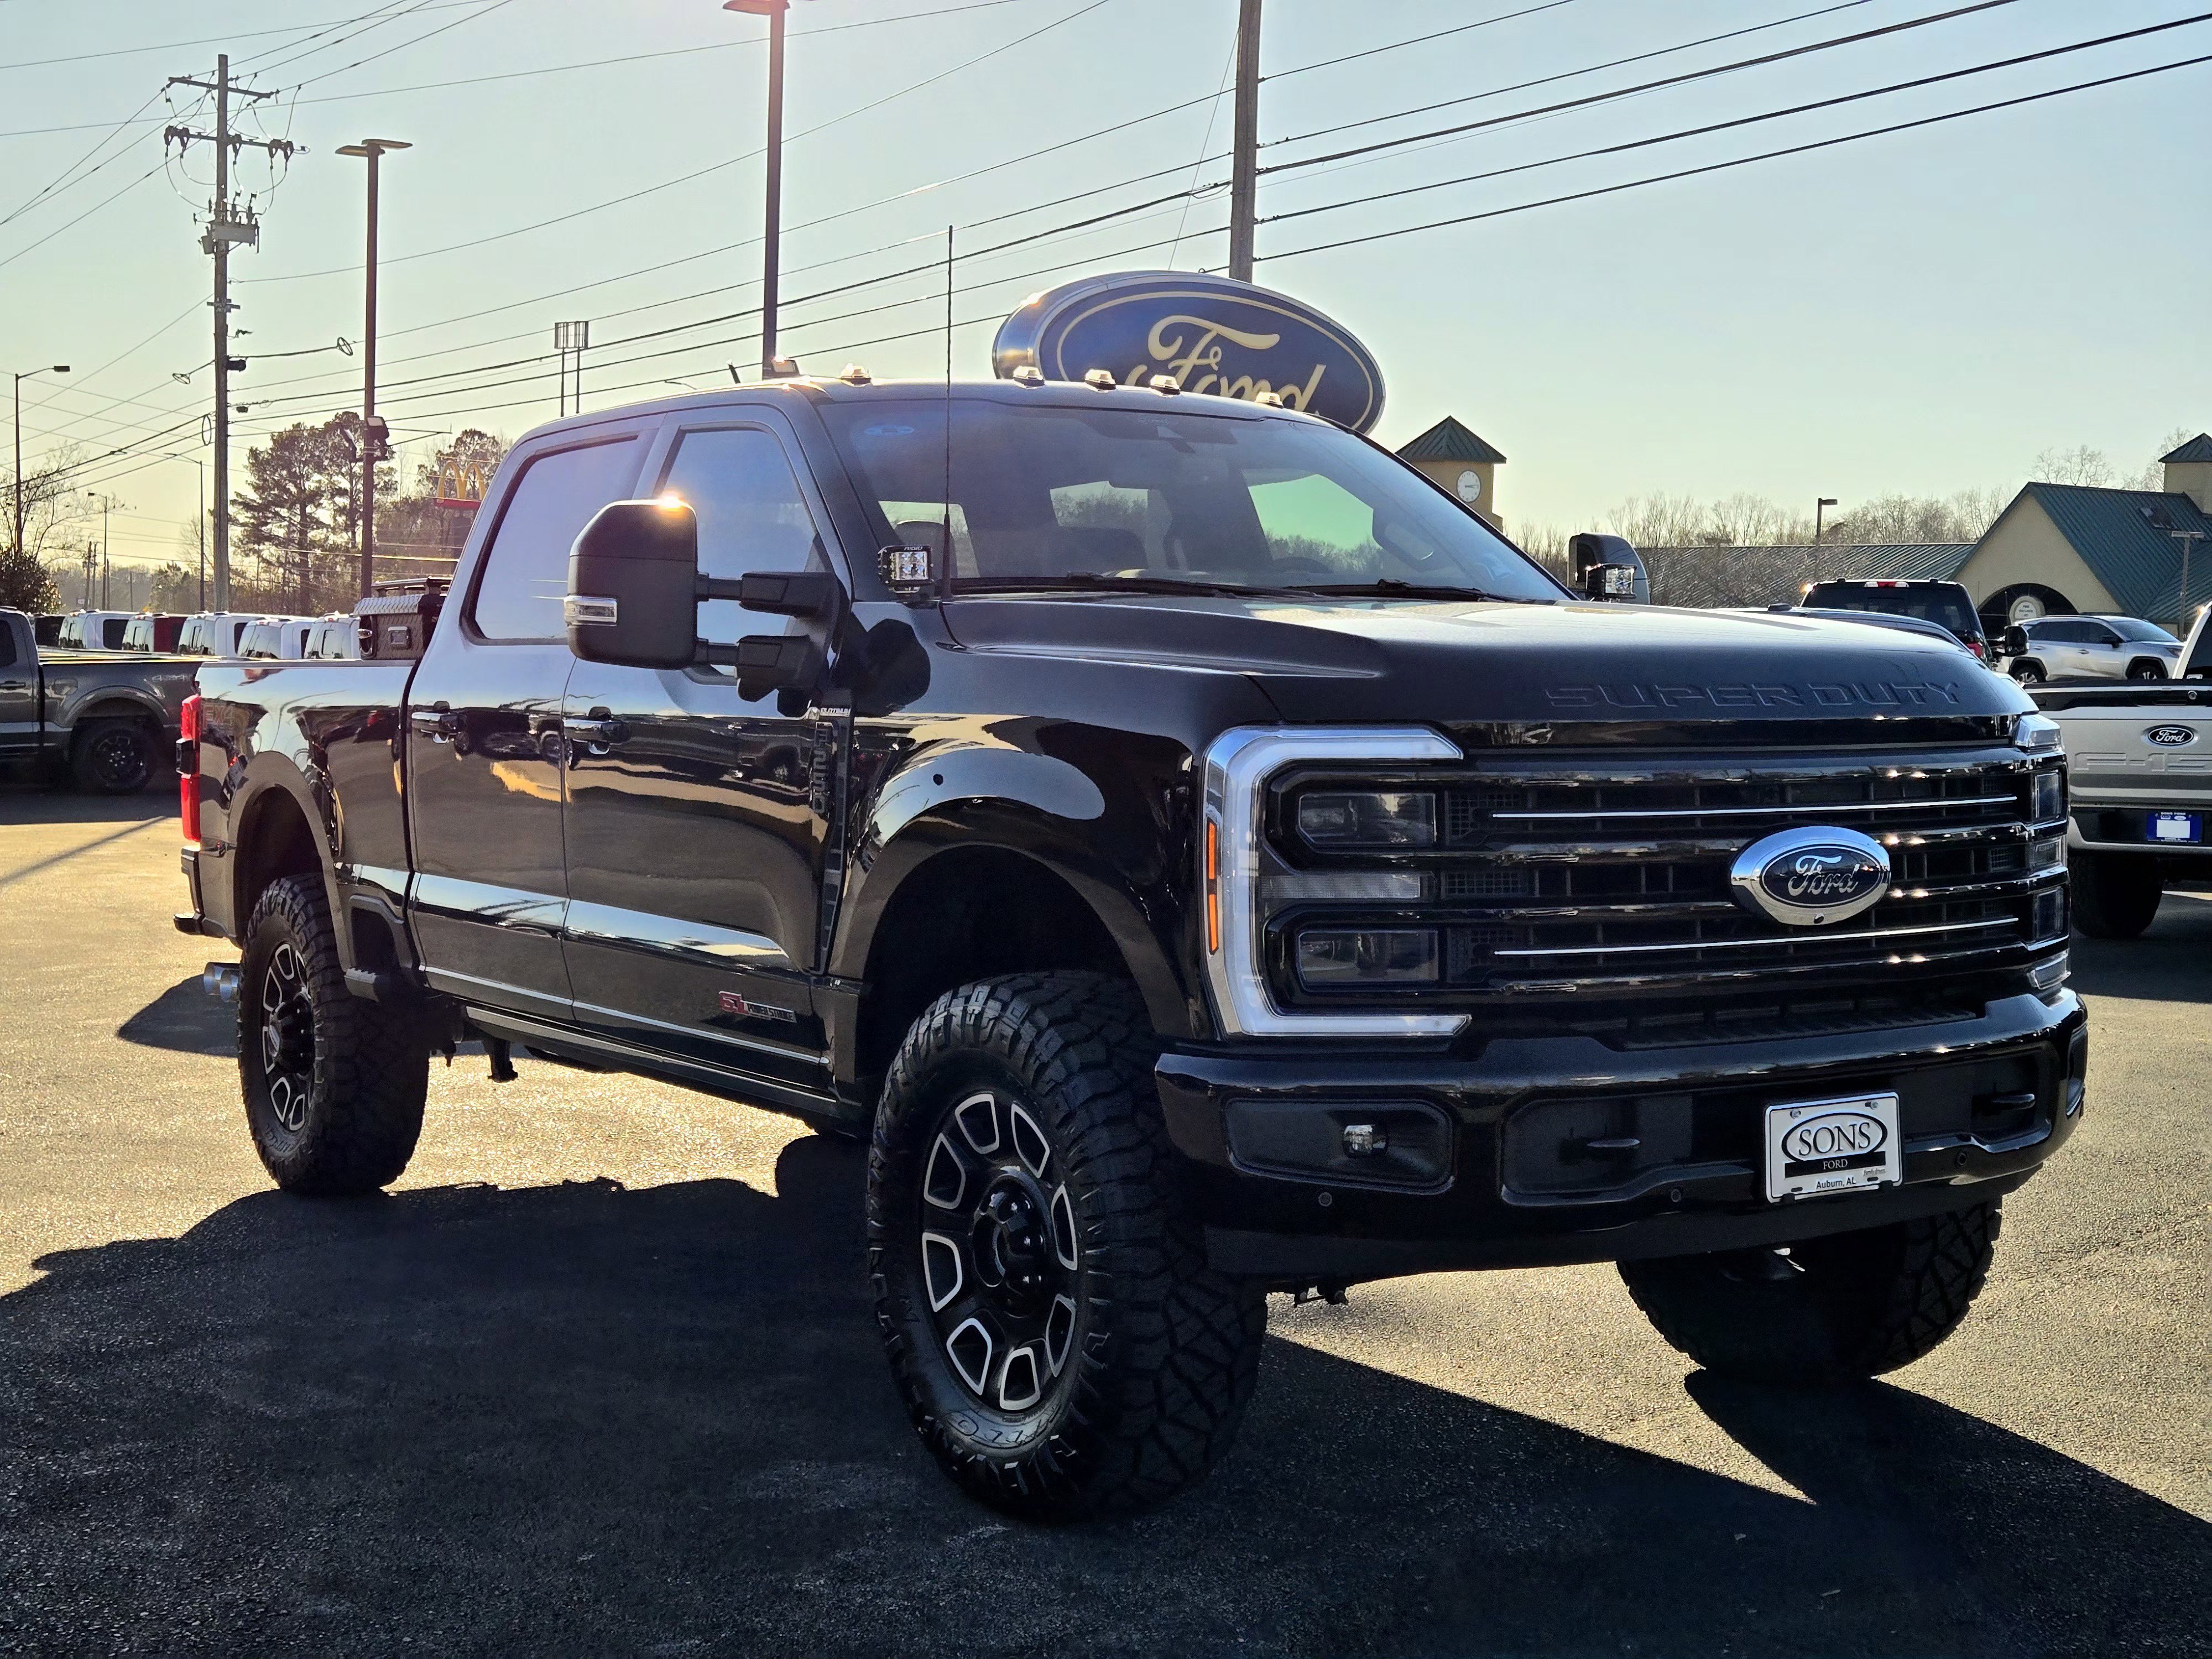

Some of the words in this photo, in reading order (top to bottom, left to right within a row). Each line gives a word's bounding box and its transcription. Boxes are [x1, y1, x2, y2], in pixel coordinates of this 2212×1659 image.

[1544, 683, 1805, 708] SUPER
[1807, 681, 1960, 705] DUTY
[2156, 729, 2186, 742] Ford
[1787, 855, 1860, 896] Ford
[1798, 1122, 1871, 1156] SONS
[1823, 1159, 1848, 1170] FORD
[1816, 1178, 1845, 1190] Auburn,
[1846, 1177, 1856, 1185] AL
